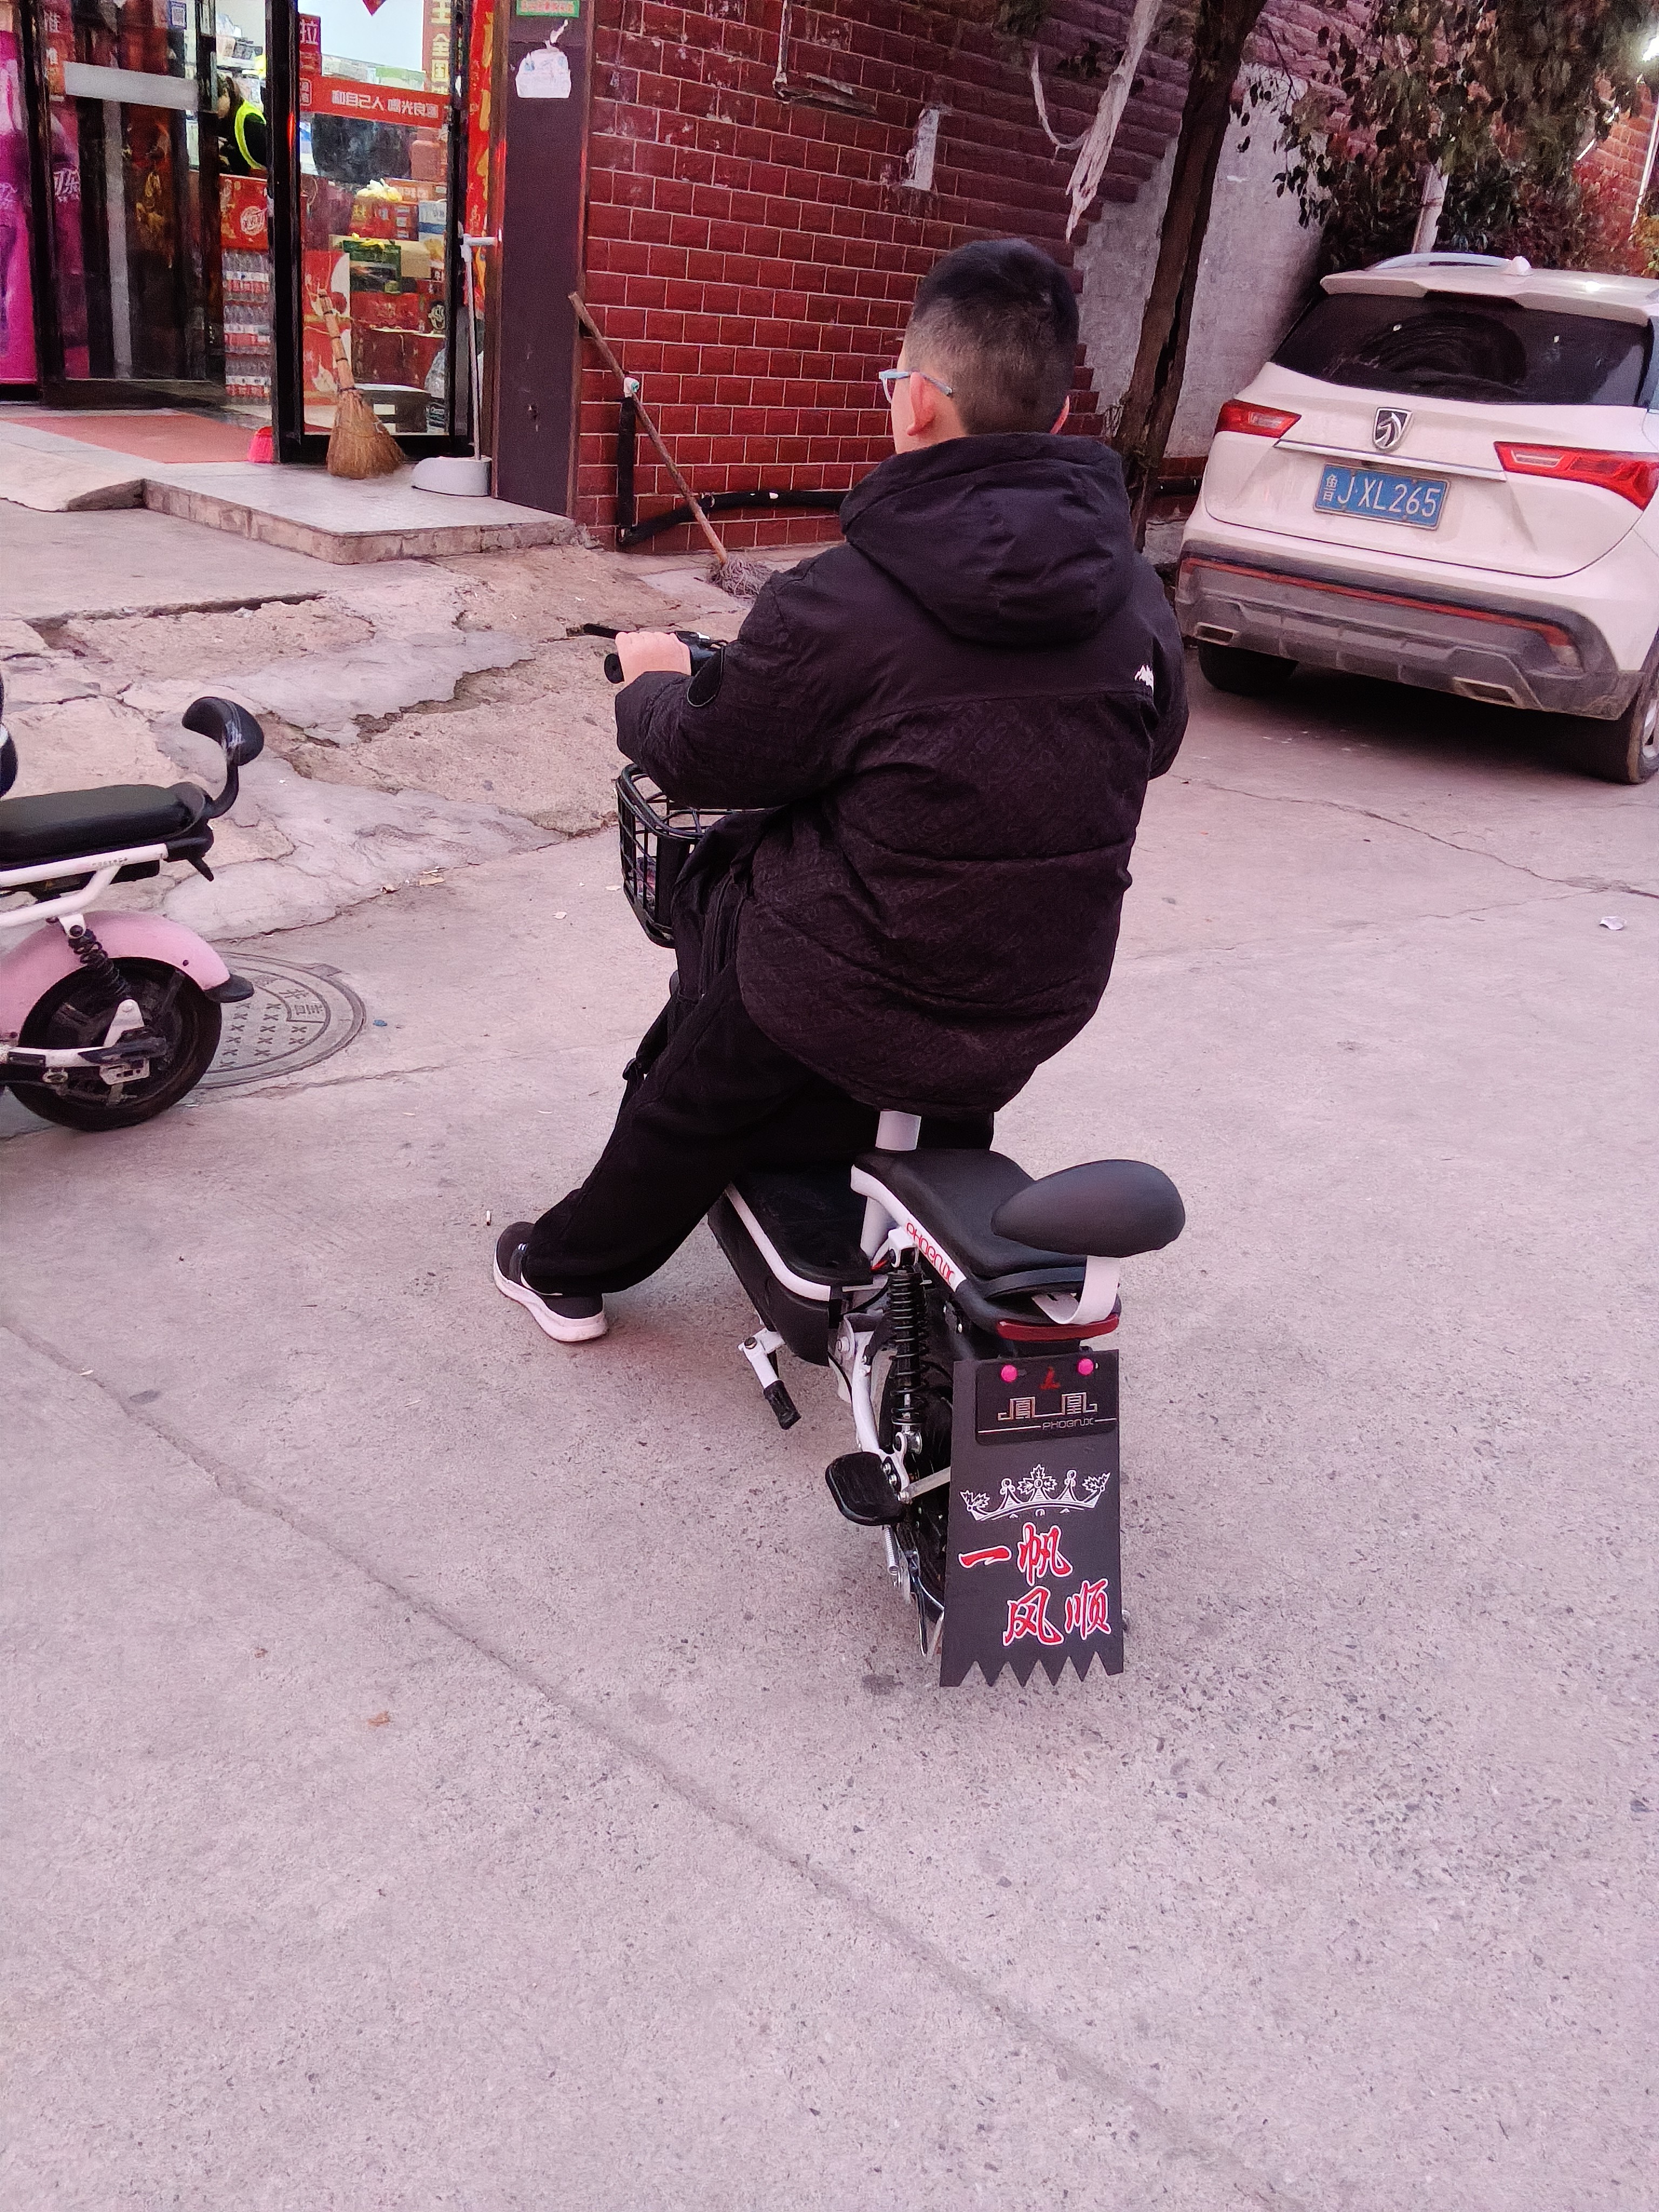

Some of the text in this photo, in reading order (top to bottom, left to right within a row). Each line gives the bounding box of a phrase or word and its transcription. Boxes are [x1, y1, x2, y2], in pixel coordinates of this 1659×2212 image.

[906, 1222, 955, 1286] PHOENIX
[1042, 1417, 1095, 1431] PHOENIX
[959, 1522, 1073, 1586] 一帆
[1003, 1578, 1111, 1645] 风顺
